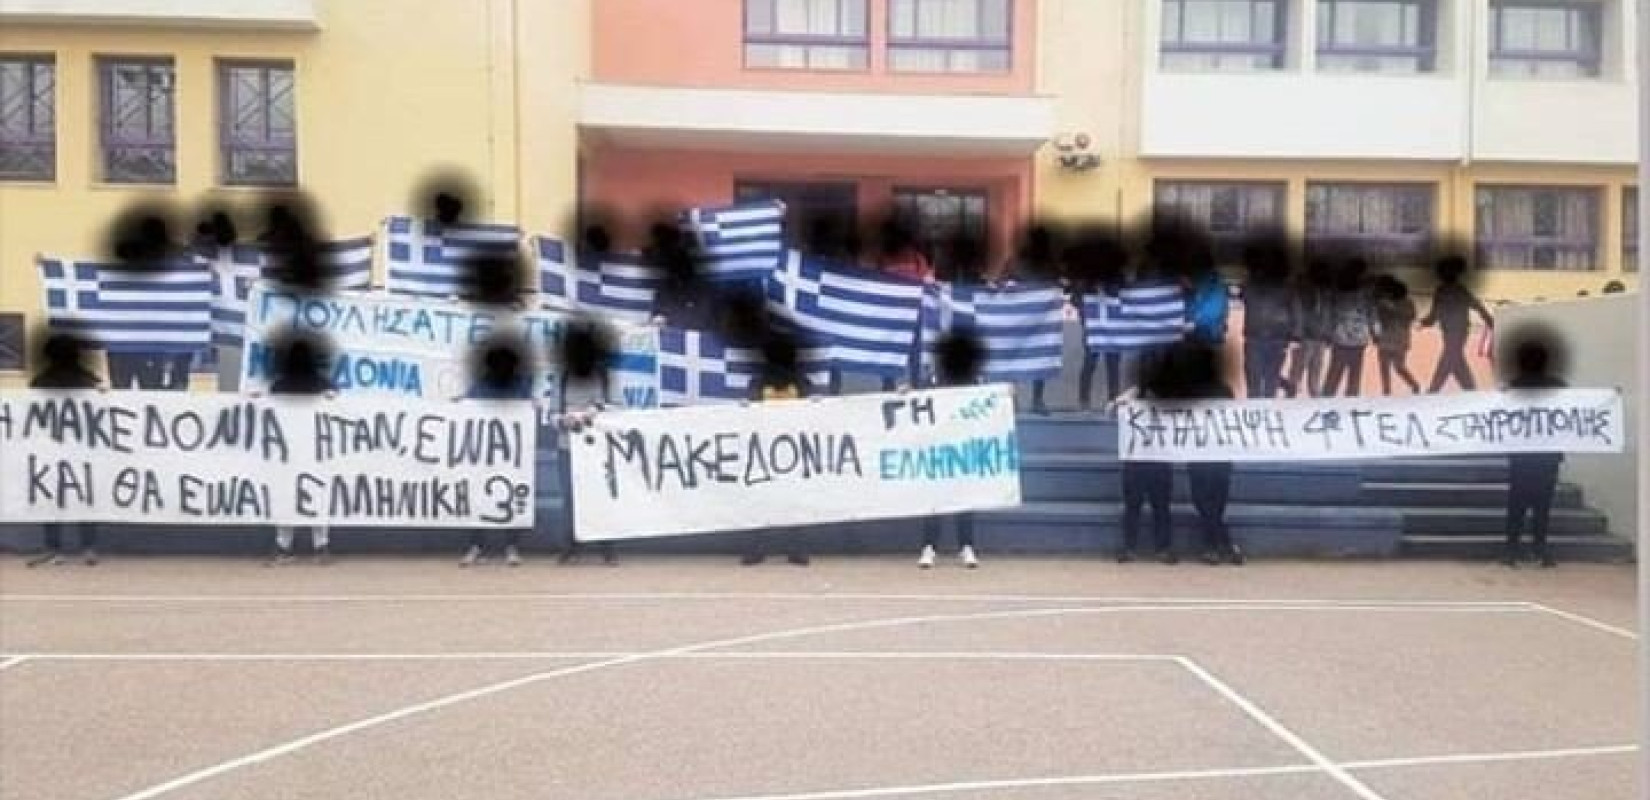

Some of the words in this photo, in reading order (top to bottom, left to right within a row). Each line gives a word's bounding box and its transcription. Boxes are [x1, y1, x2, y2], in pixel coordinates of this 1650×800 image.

[23, 397, 288, 463] ΜΑΚΕΔΟΝΙΑ
[414, 414, 521, 468] ΕΙΝΑΙ
[882, 397, 936, 431] ΓΗ
[1128, 405, 1291, 455] ΚΑΤΑΛΗΨΗ
[604, 427, 862, 500] ΜΑΚΕΔΟΝΙΑ
[879, 429, 1018, 480] ΕΛΛΗΝΙΚΗ
[28, 453, 94, 508] ΚΑΙ
[112, 467, 163, 511] ΘΑ
[180, 474, 271, 519] ΕΙΝΑΙ
[296, 472, 471, 519] ΕΛΛΗΝΙΚΗ
